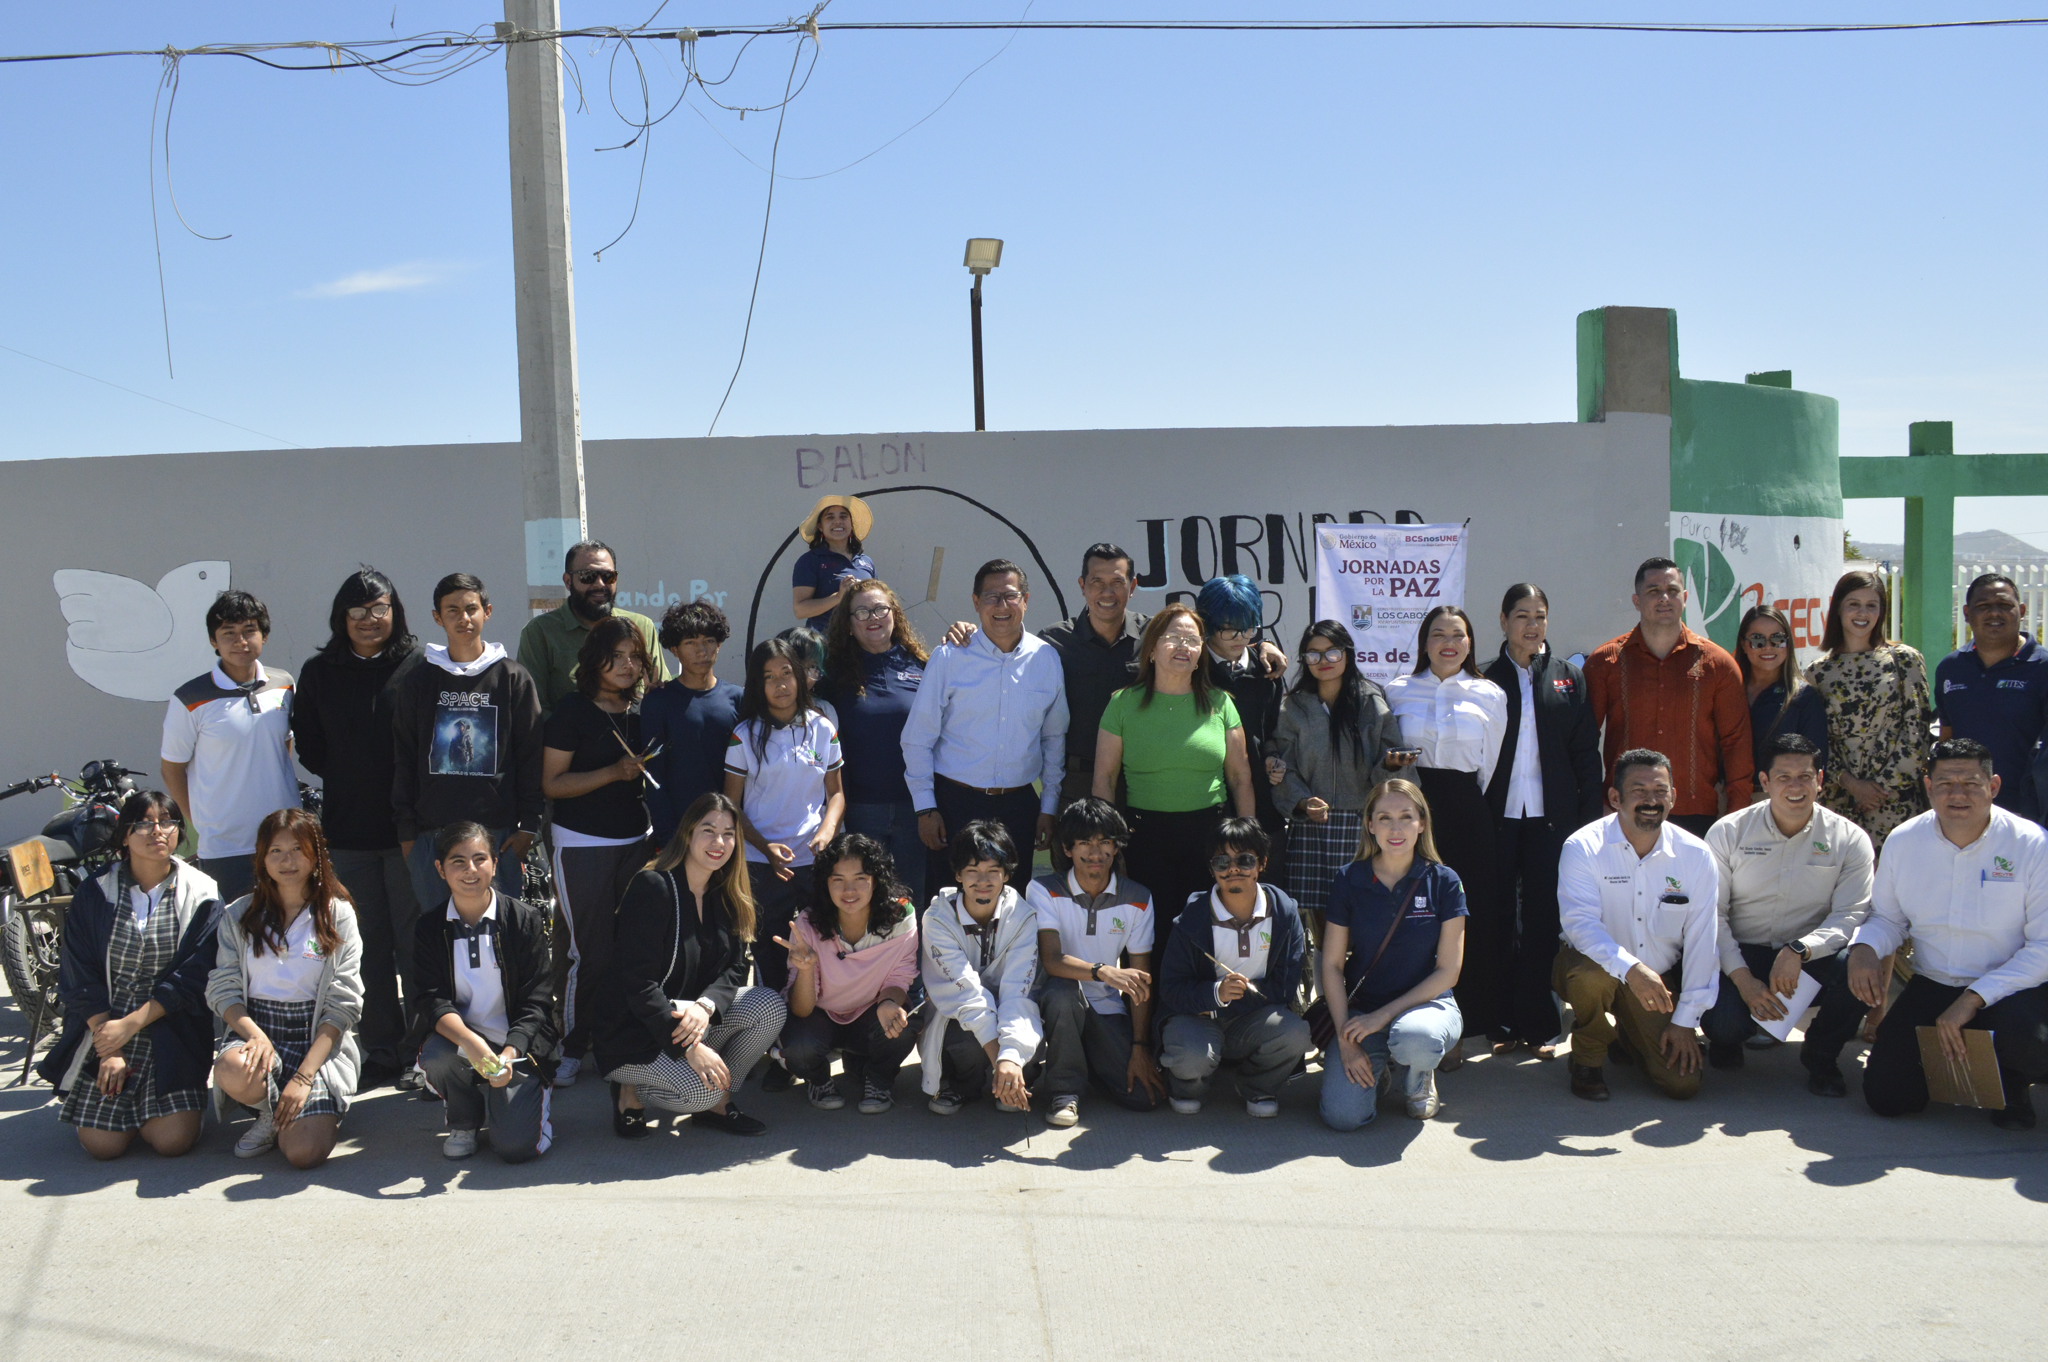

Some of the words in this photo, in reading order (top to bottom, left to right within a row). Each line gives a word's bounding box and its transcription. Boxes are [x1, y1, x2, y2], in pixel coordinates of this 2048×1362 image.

[1339, 539, 1377, 549] México
[1338, 560, 1441, 574] JORNADAS
[1372, 588, 1385, 596] LA
[1389, 577, 1441, 597] PAZ
[1385, 648, 1410, 663] de
[440, 691, 490, 707] SPACE
